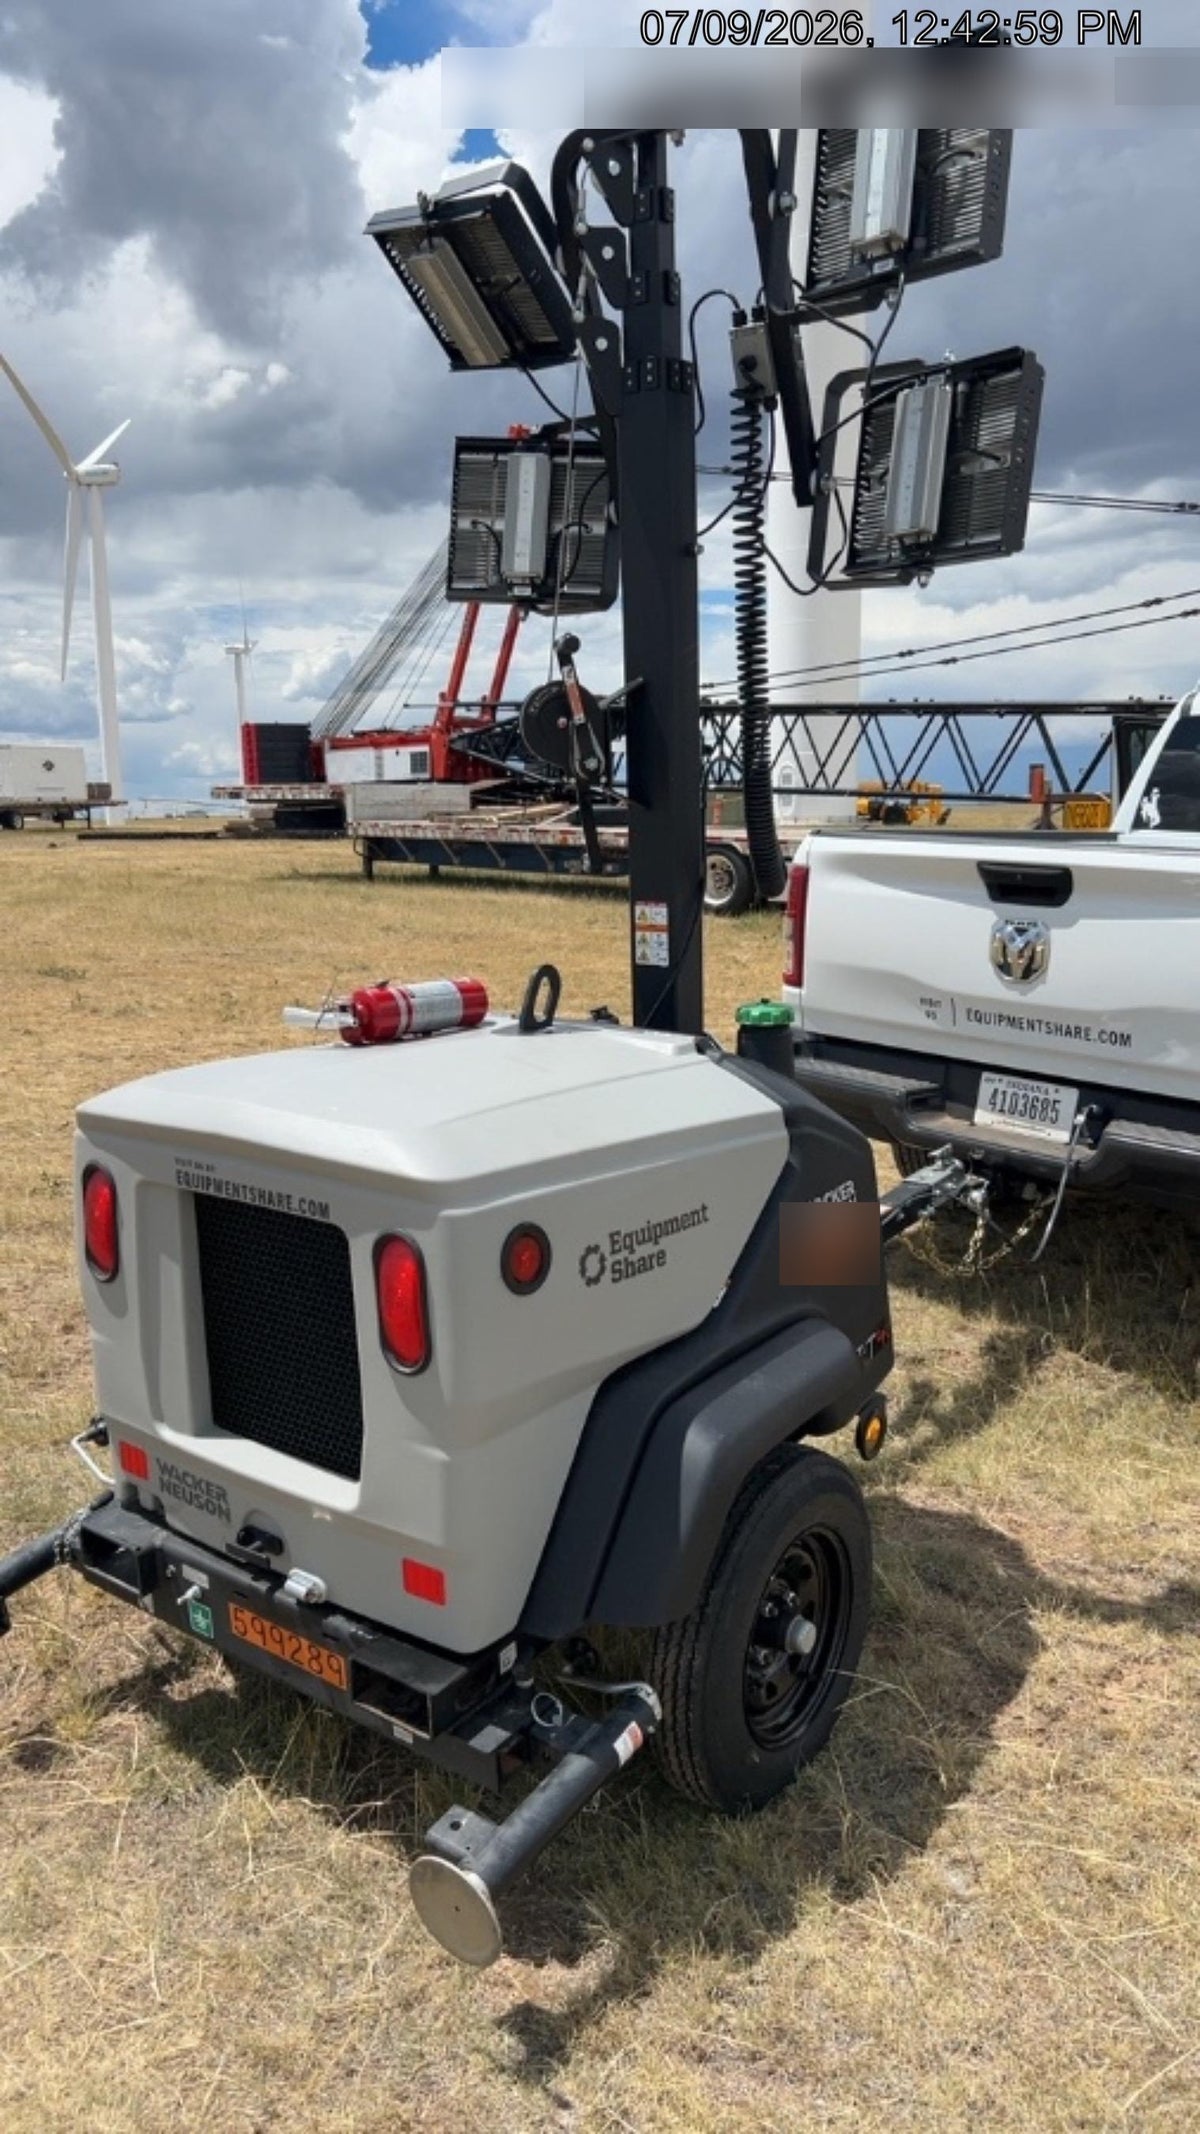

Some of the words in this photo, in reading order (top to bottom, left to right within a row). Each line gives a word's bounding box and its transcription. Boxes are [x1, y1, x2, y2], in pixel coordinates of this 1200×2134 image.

[966, 1007, 1132, 1047] EQUIPMENTSHARE.COM
[988, 1087, 1061, 1125] 4103685
[175, 1169, 330, 1219] EQUIPMENTSHARE.COM
[809, 1180, 857, 1202] CKER
[608, 1203, 709, 1256] Equipment
[610, 1249, 667, 1284] Share
[156, 1458, 229, 1501] WACKER
[159, 1475, 231, 1523] NEUSON
[233, 1606, 344, 1685] 599289
